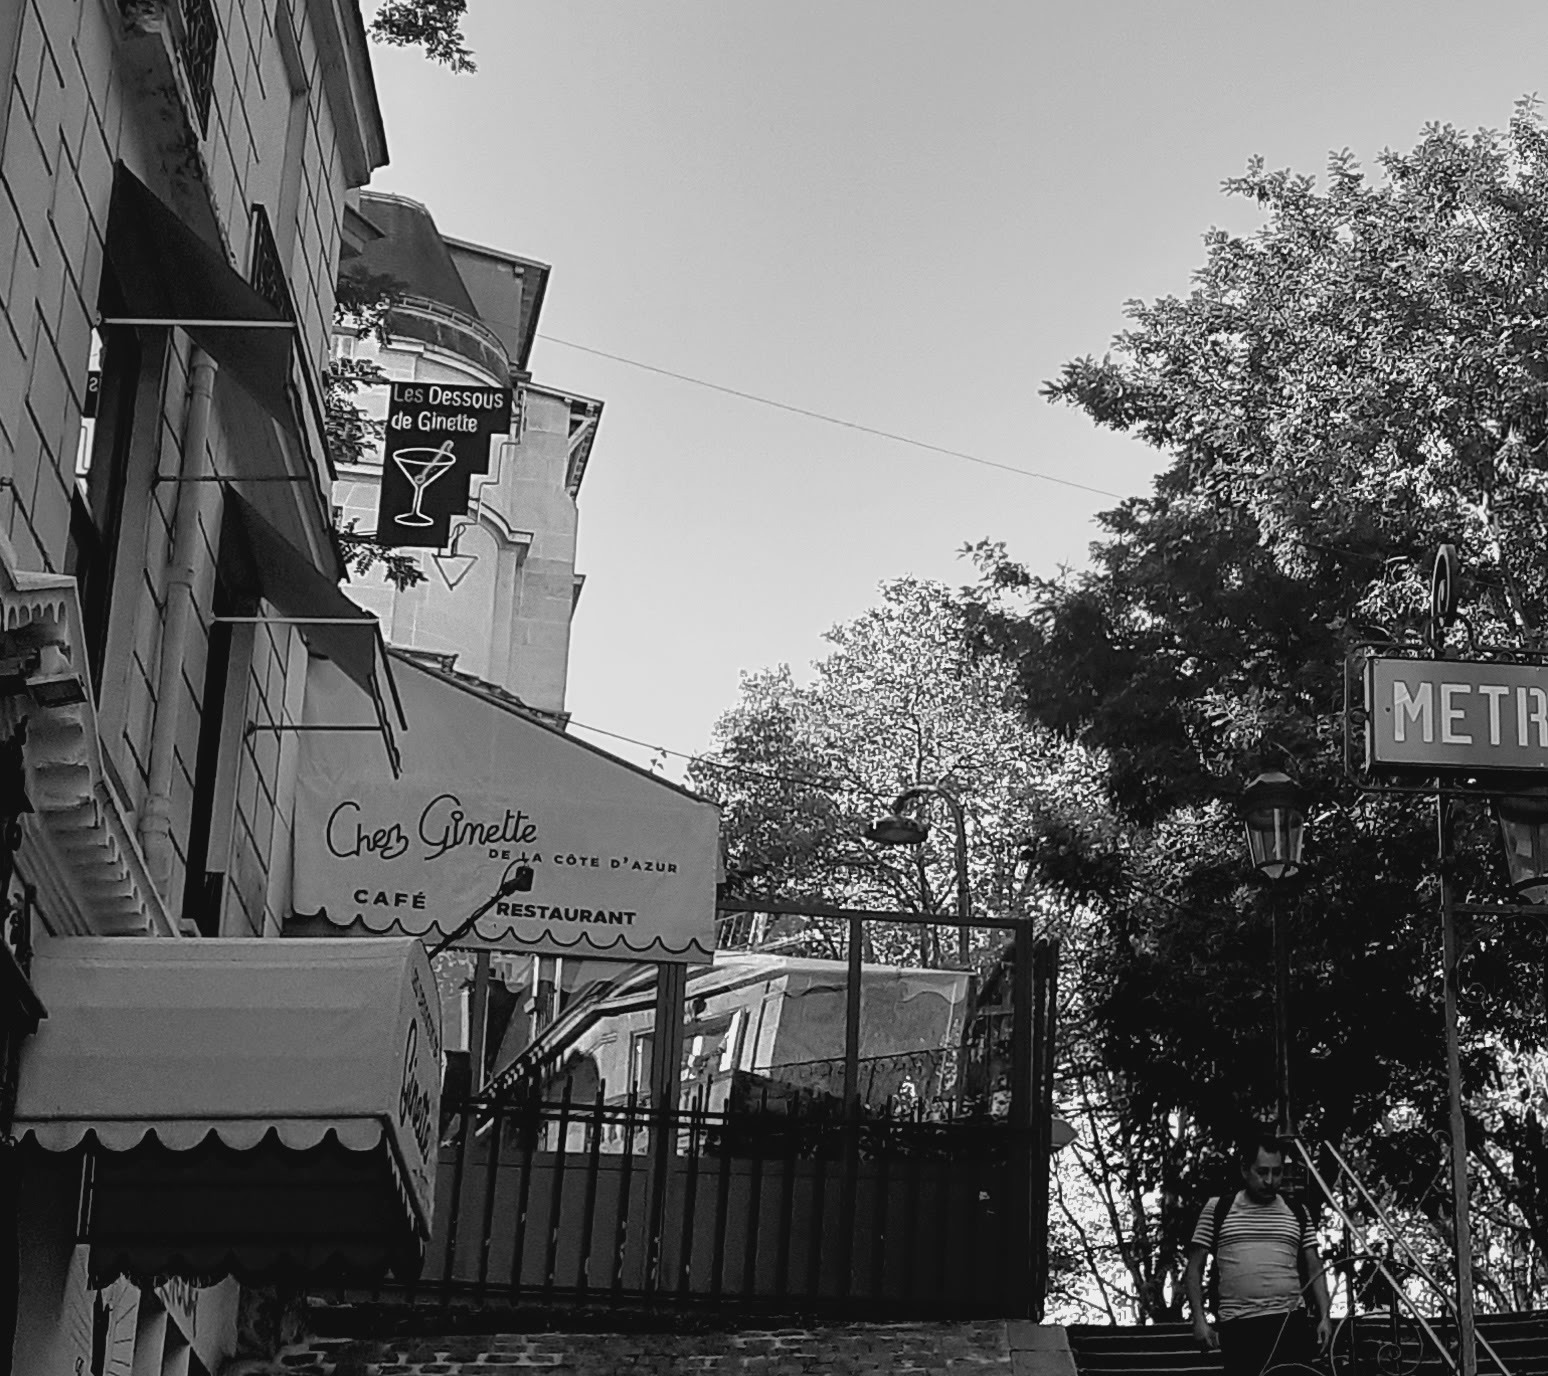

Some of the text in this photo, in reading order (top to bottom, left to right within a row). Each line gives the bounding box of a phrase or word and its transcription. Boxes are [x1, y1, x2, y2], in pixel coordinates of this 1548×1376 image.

[393, 383, 504, 409] Les Dessous
[390, 410, 478, 433] de Ginette
[326, 794, 537, 860] Chez Ginette
[488, 848, 678, 874] DE LA CÔTE D'AZUR
[353, 888, 426, 910] CAFÉ
[496, 902, 637, 926] RESTAURANT
